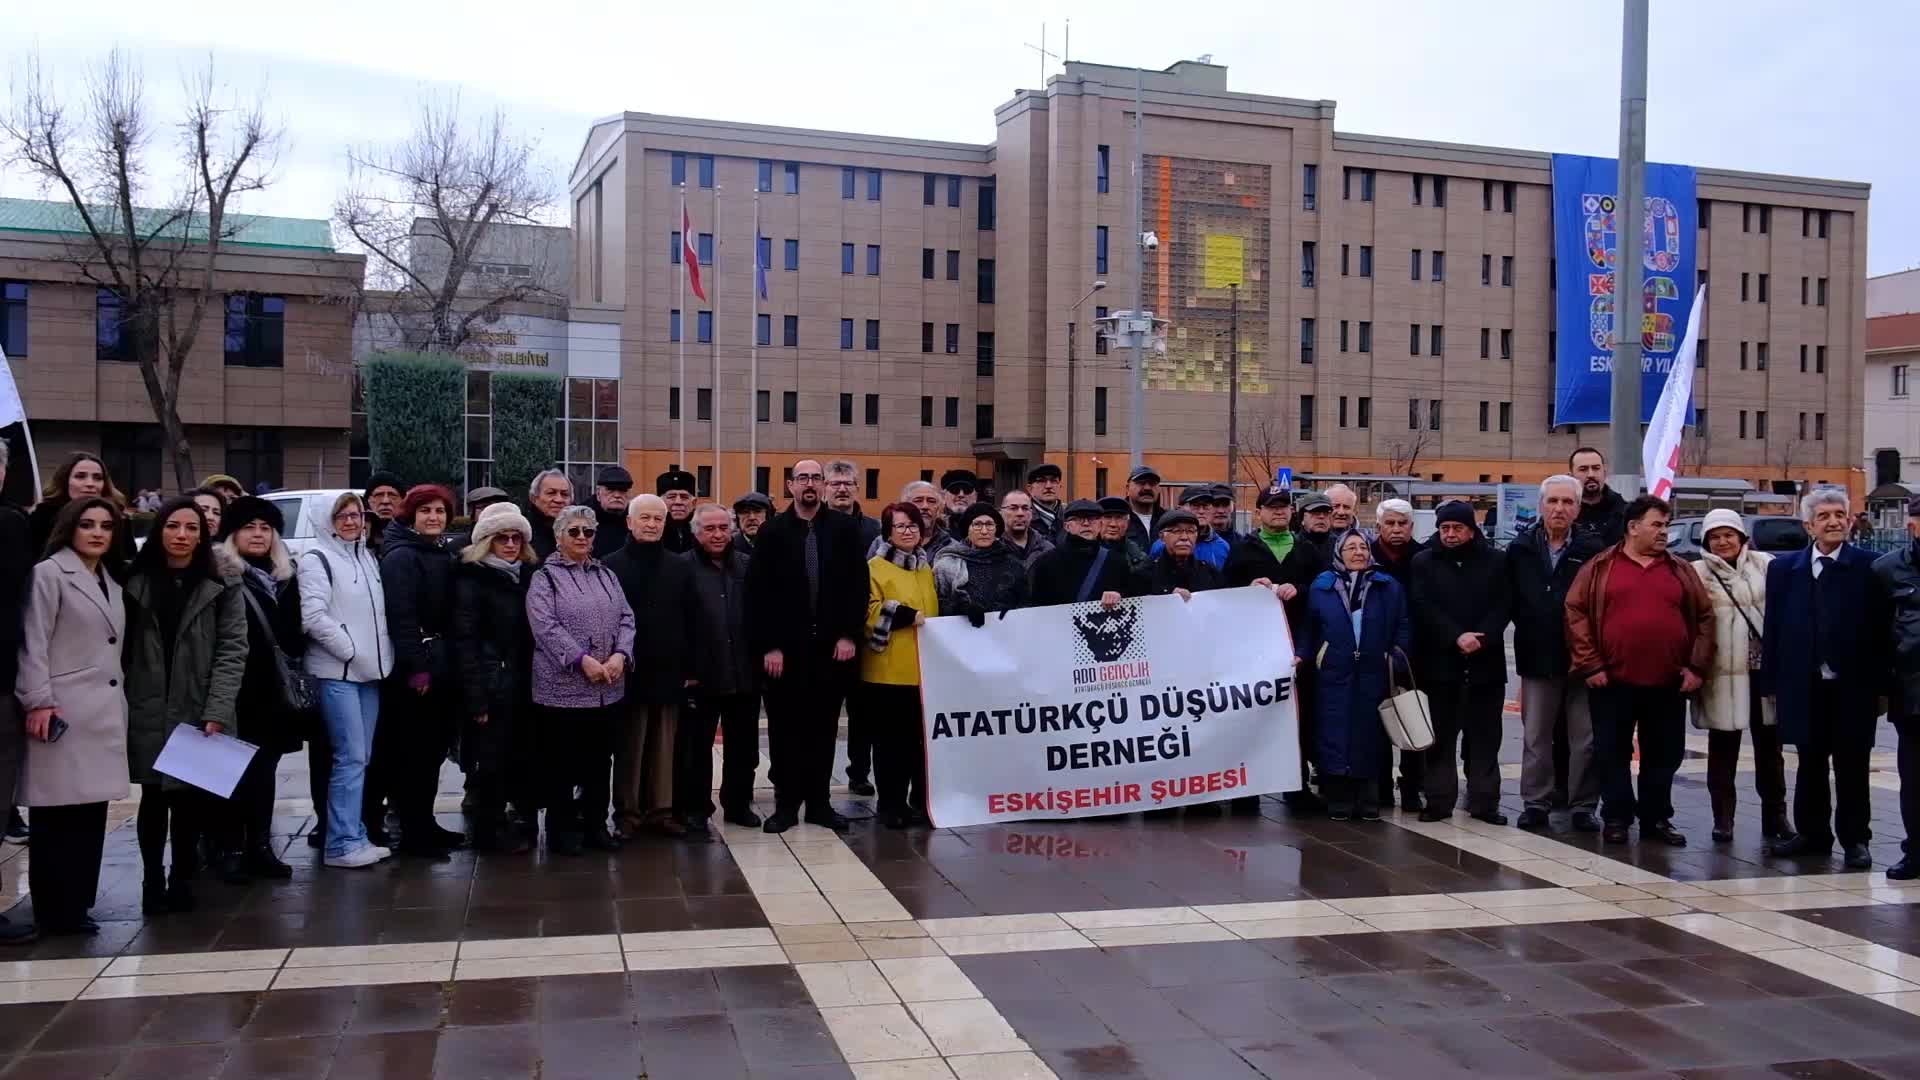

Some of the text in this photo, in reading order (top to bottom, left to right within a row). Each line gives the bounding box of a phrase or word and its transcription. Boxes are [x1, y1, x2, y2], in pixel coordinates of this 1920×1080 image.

[1590, 353, 1652, 373] ESKİR
[1073, 667, 1097, 685] ADD
[931, 676, 1293, 741] ATATÜRKÇÜ DÜŞÜNCE
[1046, 725, 1191, 772] DERNEĞİ
[988, 762, 1248, 815] ESKİŞEHİR ŞUBESİ
